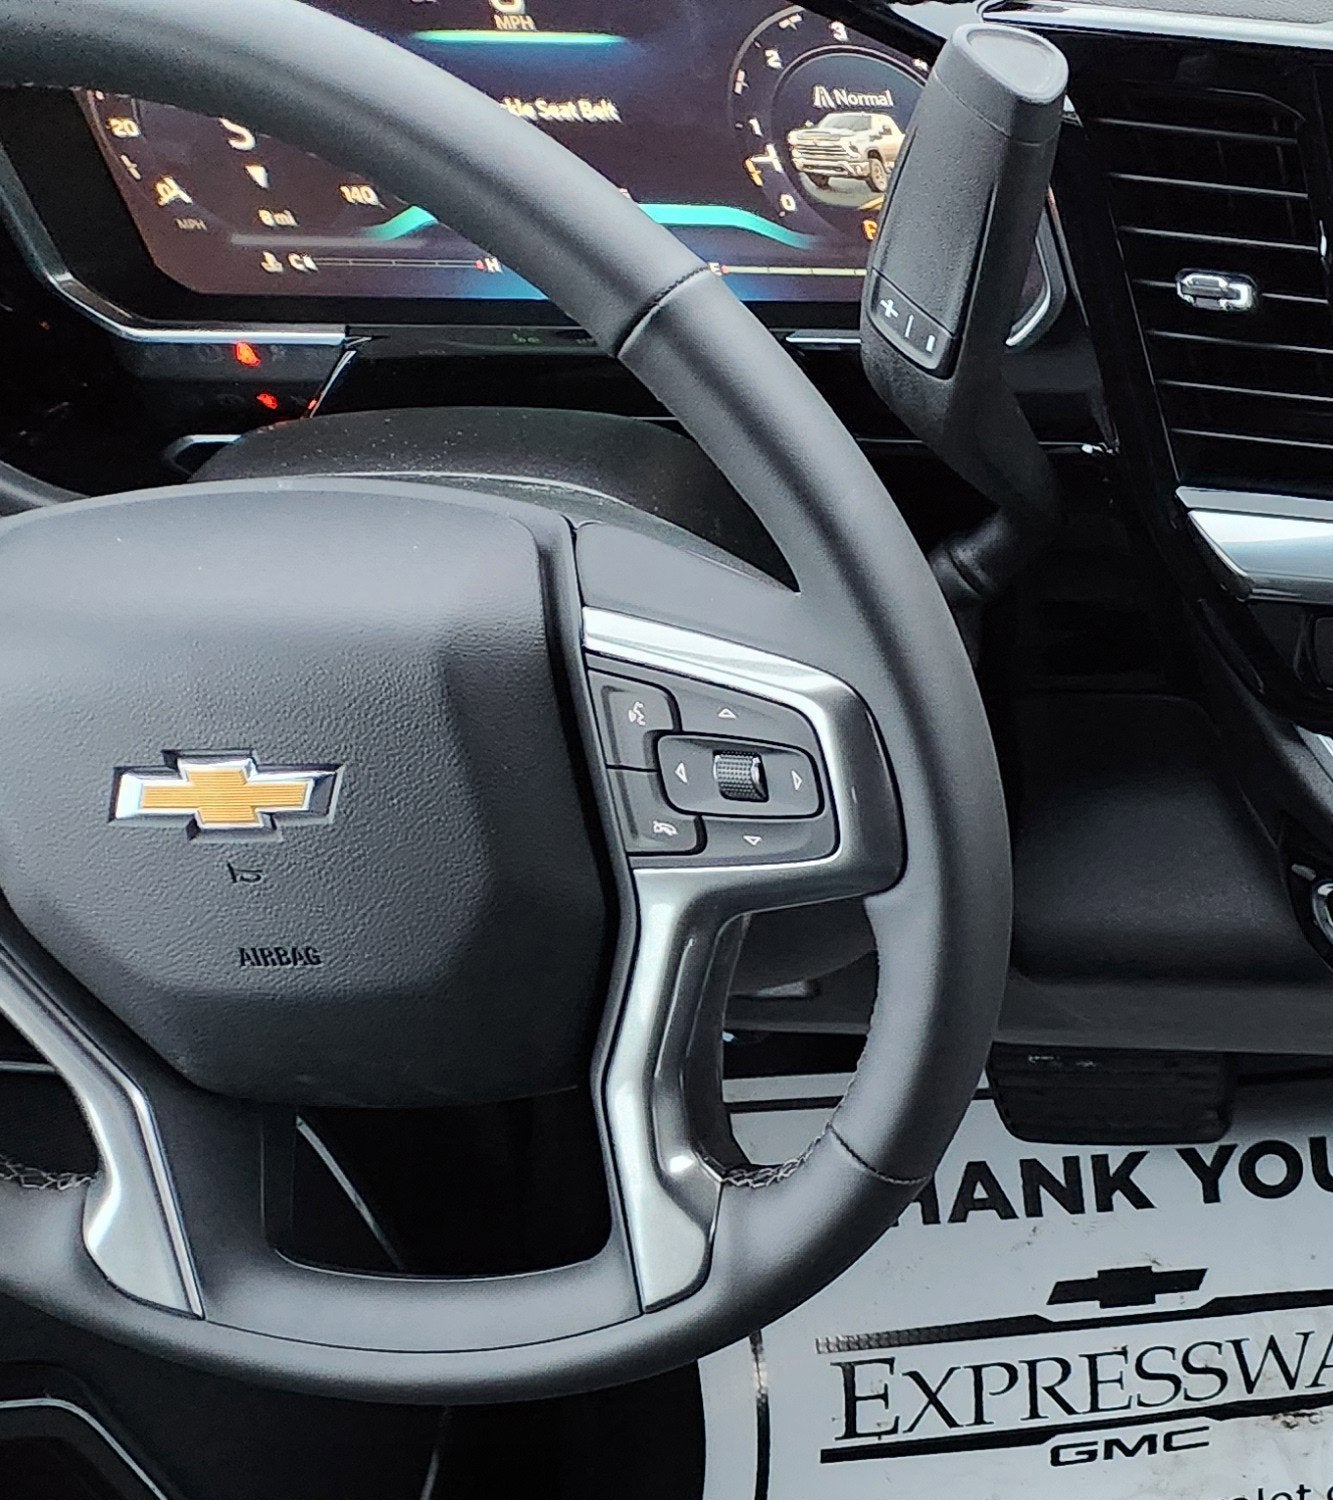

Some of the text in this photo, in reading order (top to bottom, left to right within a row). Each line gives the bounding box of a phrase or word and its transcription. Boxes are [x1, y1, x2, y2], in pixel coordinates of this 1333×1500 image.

[494, 14, 538, 32] MPH
[764, 48, 782, 69] 2
[833, 88, 895, 108] Normal
[534, 98, 583, 122] Seat
[578, 98, 623, 123] Belt
[107, 116, 142, 139] 20
[338, 183, 381, 206] 140
[239, 946, 323, 968] AIRBAG
[1048, 1426, 1211, 1468] GMC
